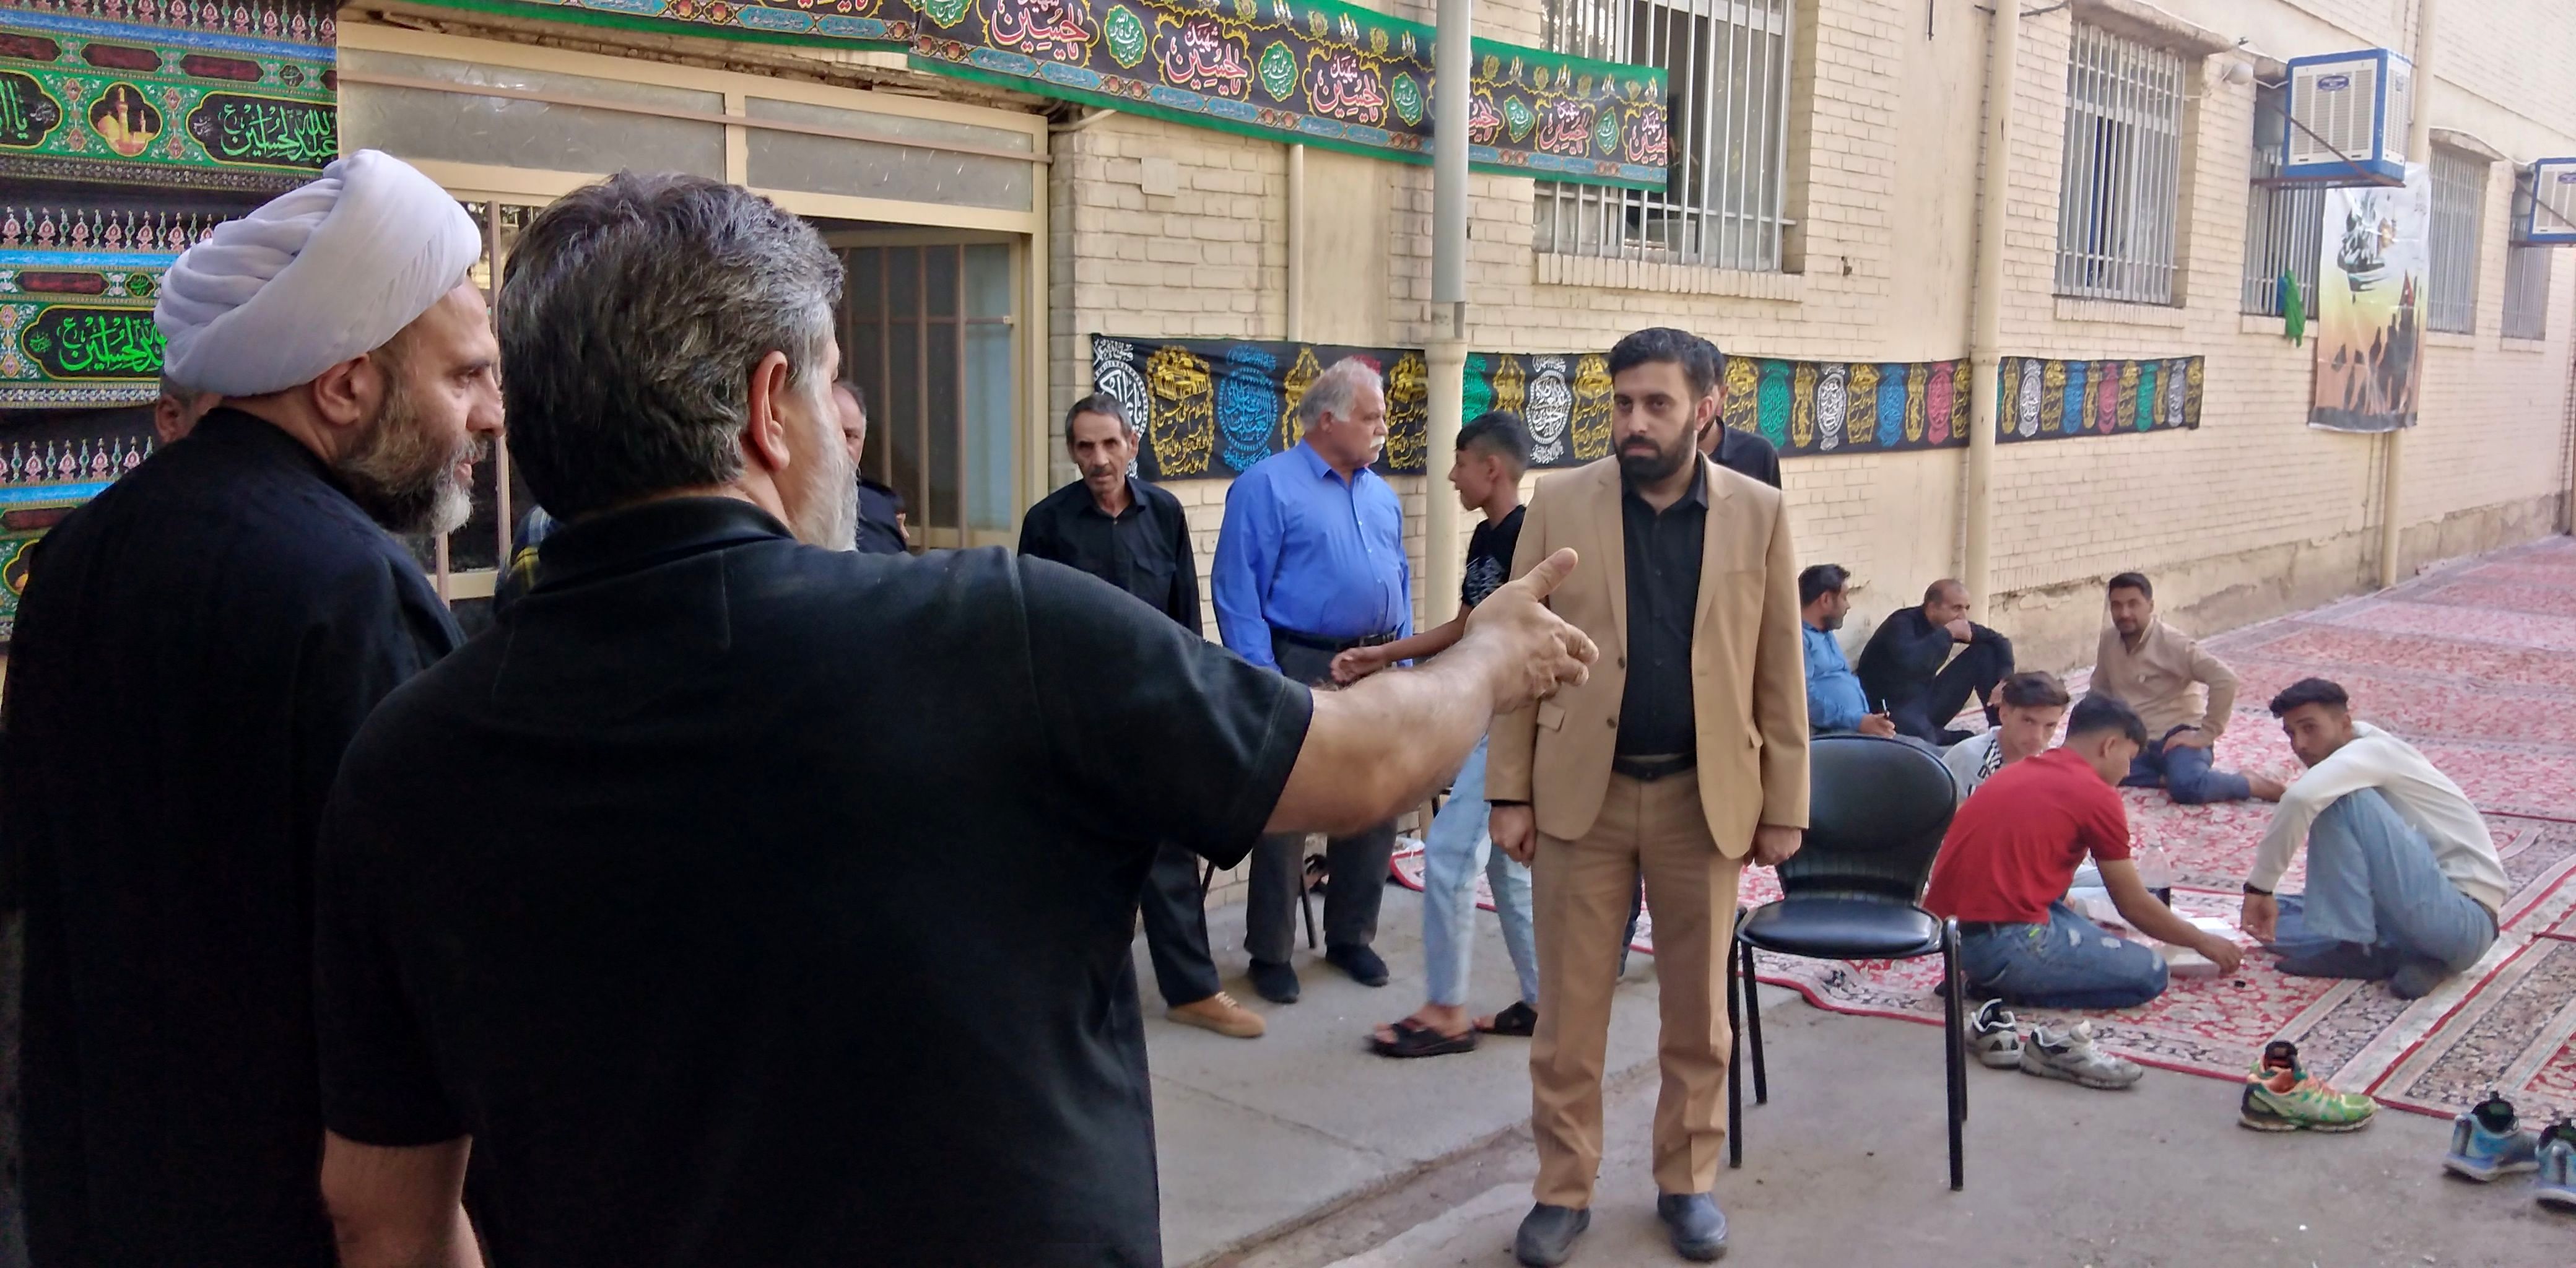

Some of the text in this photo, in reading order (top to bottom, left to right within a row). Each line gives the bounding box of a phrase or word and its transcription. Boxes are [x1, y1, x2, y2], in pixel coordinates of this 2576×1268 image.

[1116, 14, 1128, 22] الله
[1125, 21, 1134, 38] علی
[1115, 30, 1139, 44] محمد
[1271, 50, 1284, 60] الله
[1268, 65, 1292, 79] محمد
[1277, 57, 1287, 73] علی
